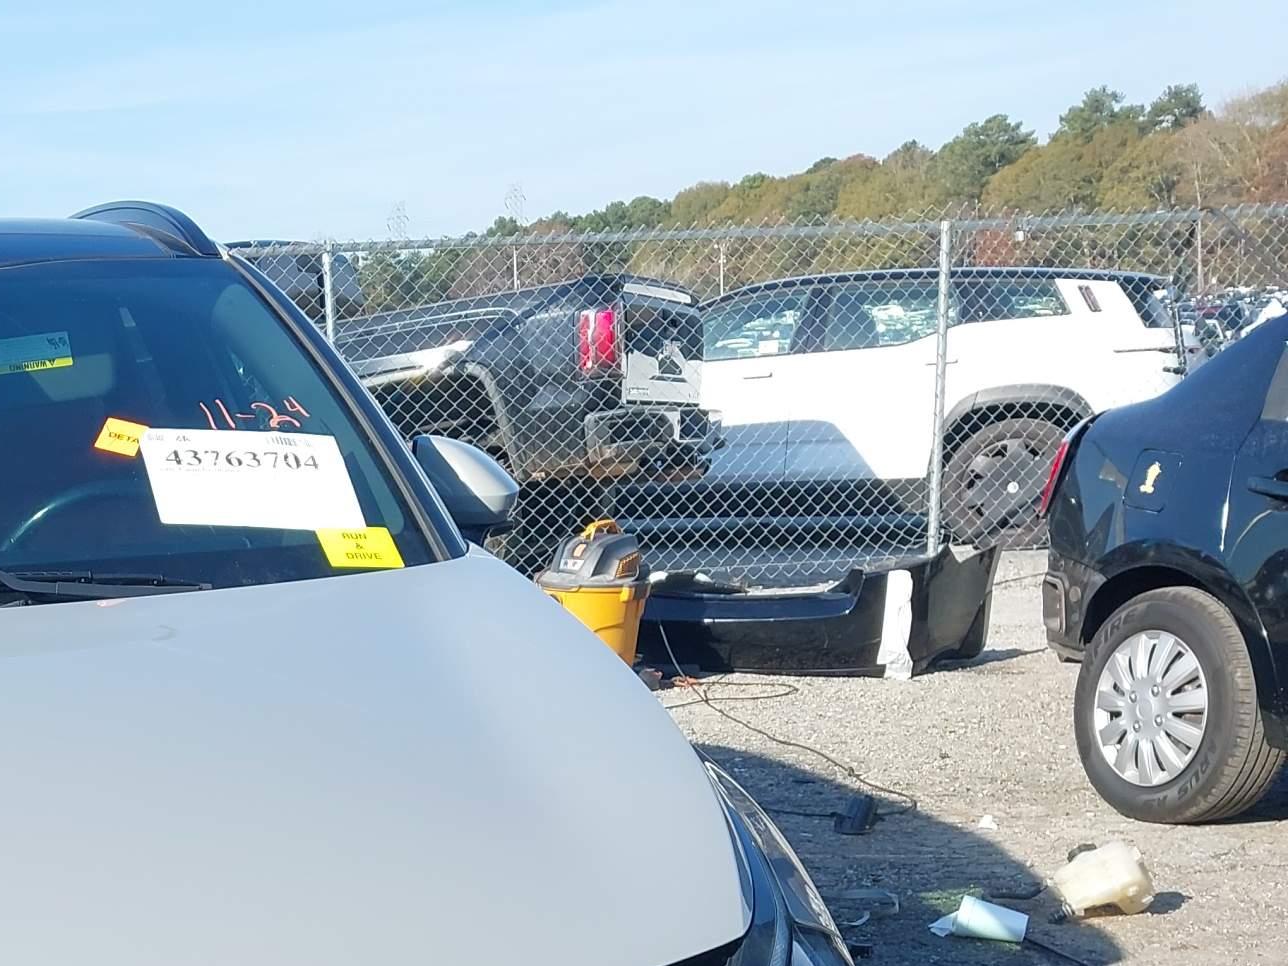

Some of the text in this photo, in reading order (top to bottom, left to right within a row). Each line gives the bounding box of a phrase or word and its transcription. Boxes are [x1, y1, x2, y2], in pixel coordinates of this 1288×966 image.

[199, 396, 310, 430] 11-24
[165, 449, 320, 470] 43763704
[342, 532, 367, 540] RUN
[345, 552, 383, 560] DRIVE
